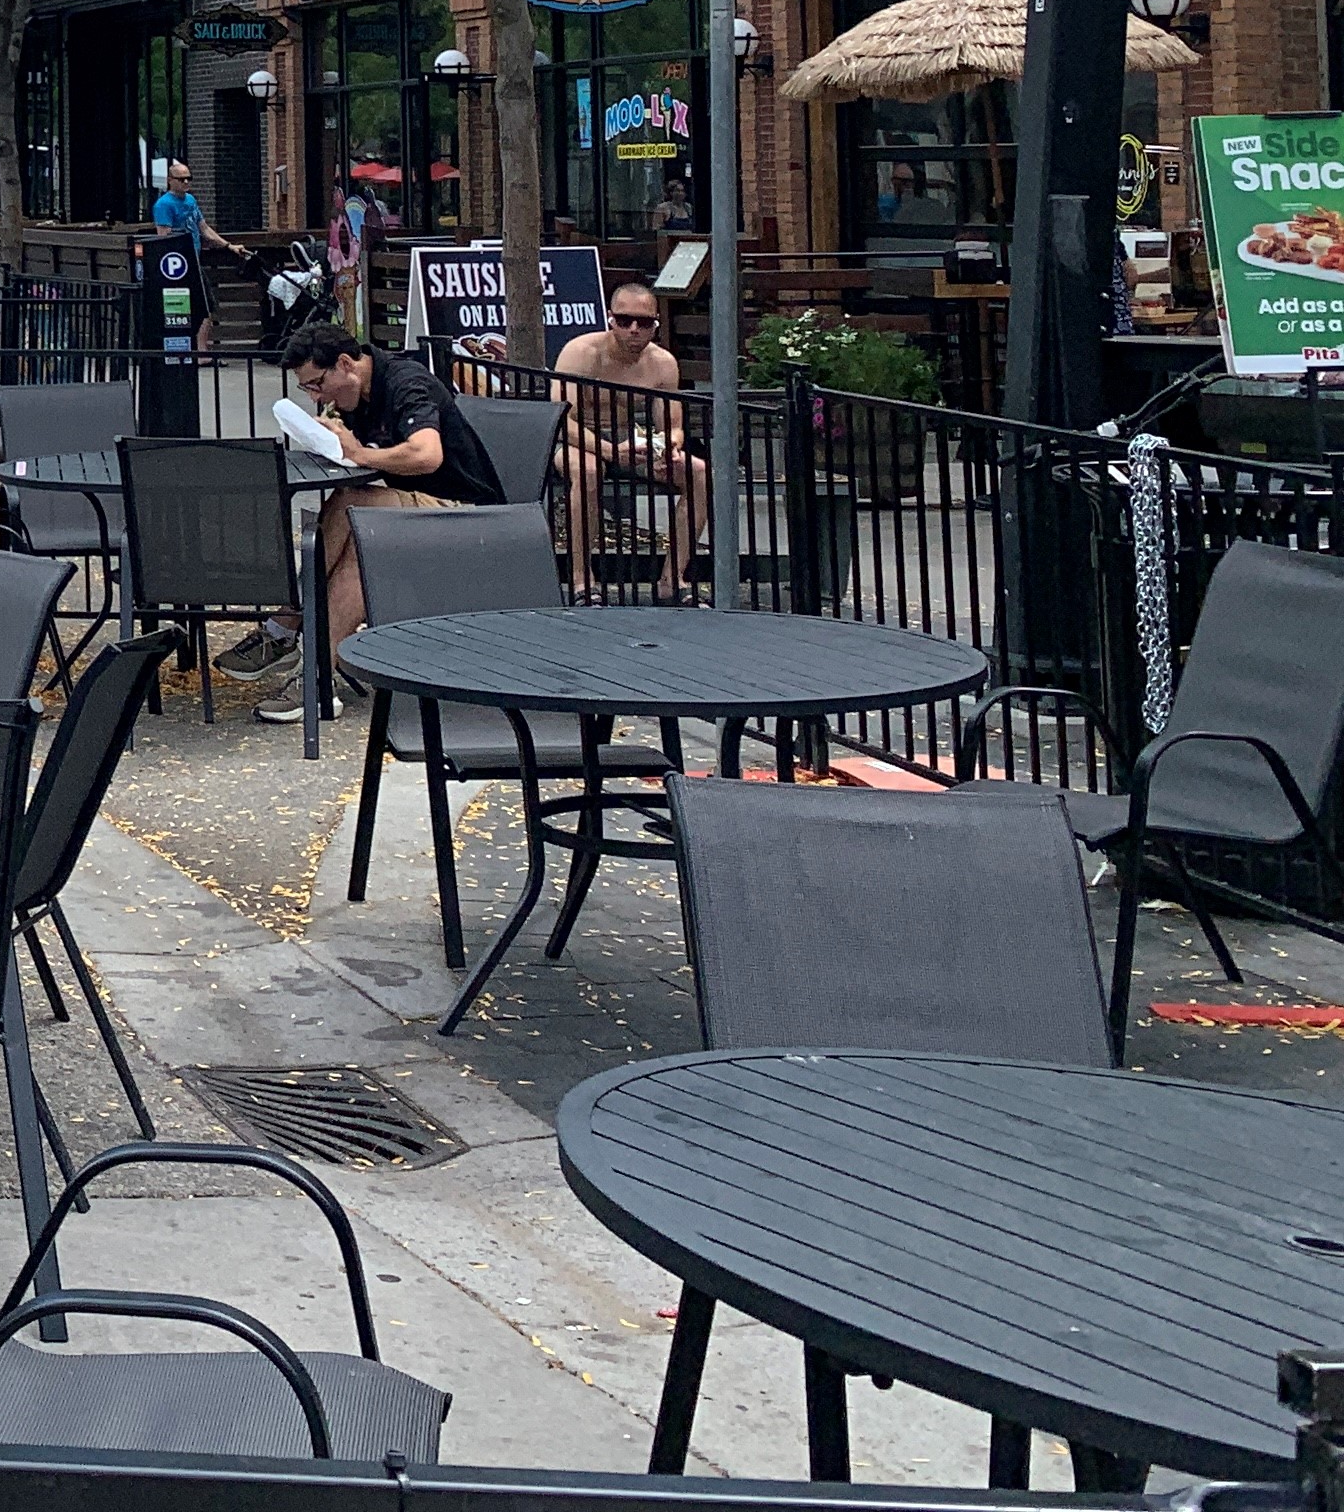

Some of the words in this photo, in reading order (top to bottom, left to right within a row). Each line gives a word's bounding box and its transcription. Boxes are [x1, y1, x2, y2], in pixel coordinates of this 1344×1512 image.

[194, 22, 220, 40] SALT
[230, 23, 267, 40] BRICK
[1227, 139, 1257, 152] NEW
[1266, 128, 1340, 159] Side
[1232, 157, 1344, 192] Snac
[428, 261, 556, 298] SAUSE
[459, 304, 484, 327] ON
[487, 304, 499, 326] A
[562, 303, 597, 325] BUN
[1259, 297, 1299, 314] Add
[1303, 300, 1327, 313] as
[1330, 300, 1344, 313] a
[1278, 320, 1298, 333] or
[1301, 319, 1326, 332] as
[1328, 319, 1342, 332] a
[1303, 348, 1340, 360] Pita
